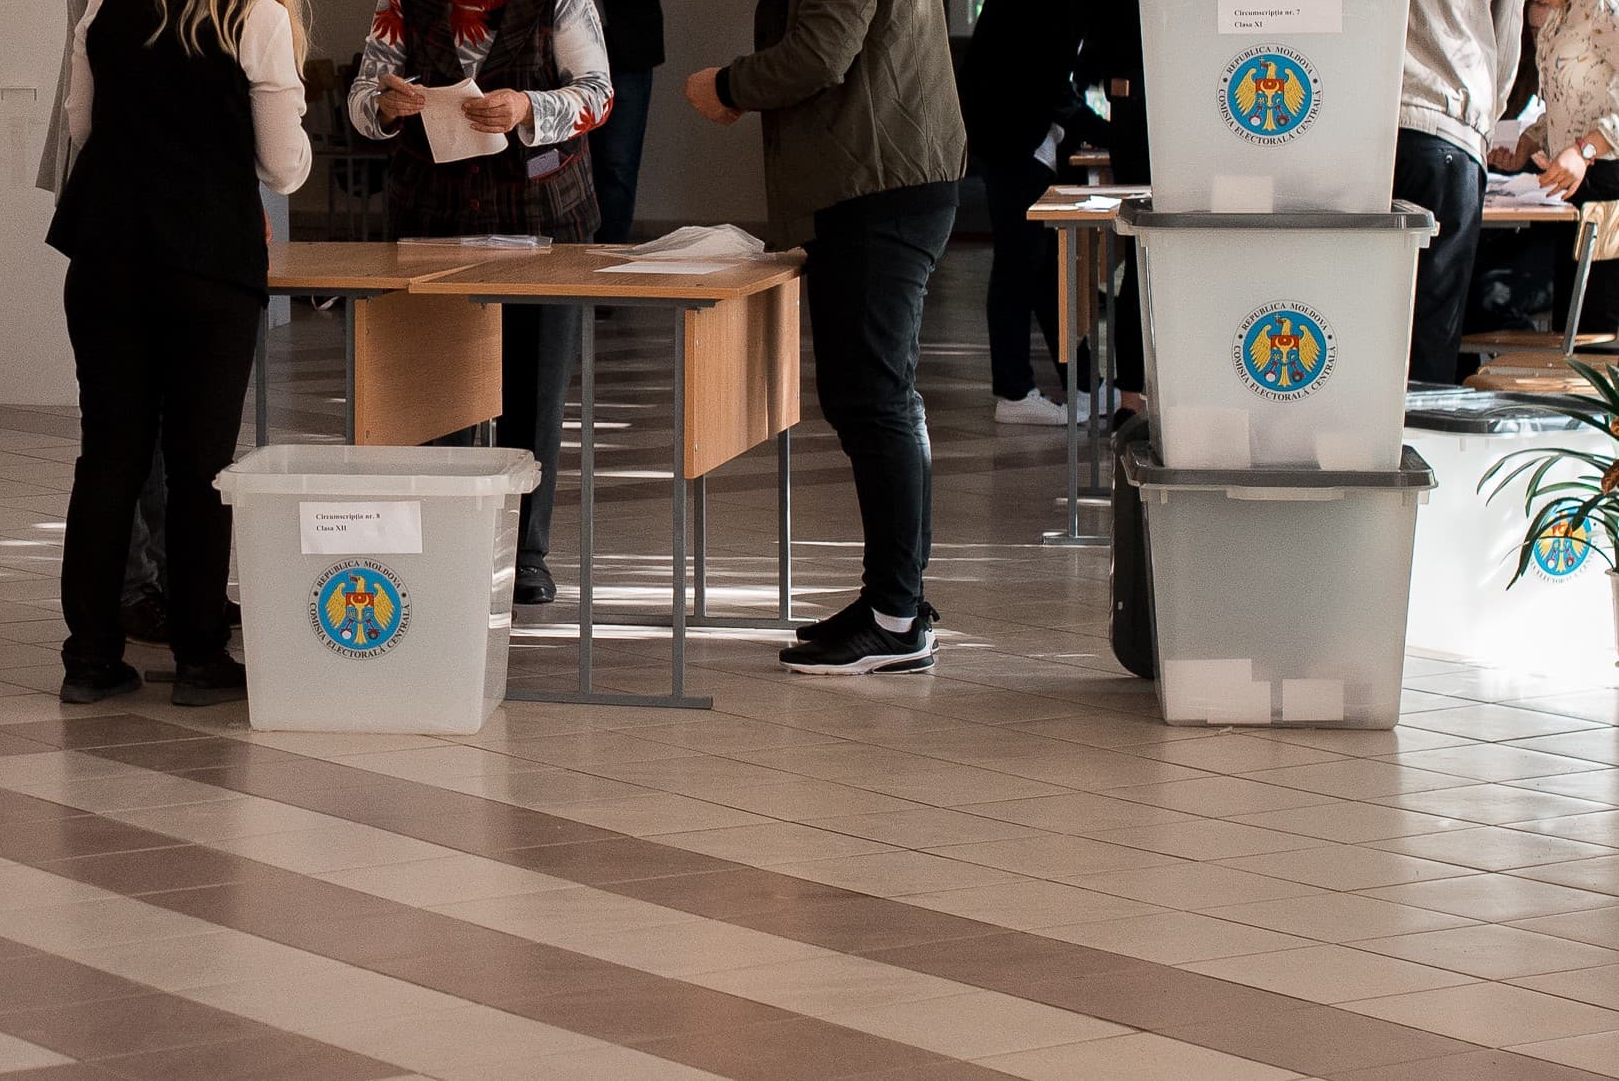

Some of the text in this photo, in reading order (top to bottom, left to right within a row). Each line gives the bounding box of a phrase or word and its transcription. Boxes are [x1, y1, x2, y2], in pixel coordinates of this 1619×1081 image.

[1226, 46, 1313, 75] REPUBLICA MOLDOVA
[1218, 89, 1236, 127] COMISIA
[1242, 302, 1328, 331] REPUBLICA MOLDOVA
[1233, 345, 1250, 384] COMISIA
[316, 560, 401, 589] REPUBLICA MOLDOVA
[309, 602, 326, 641] COMISIA
